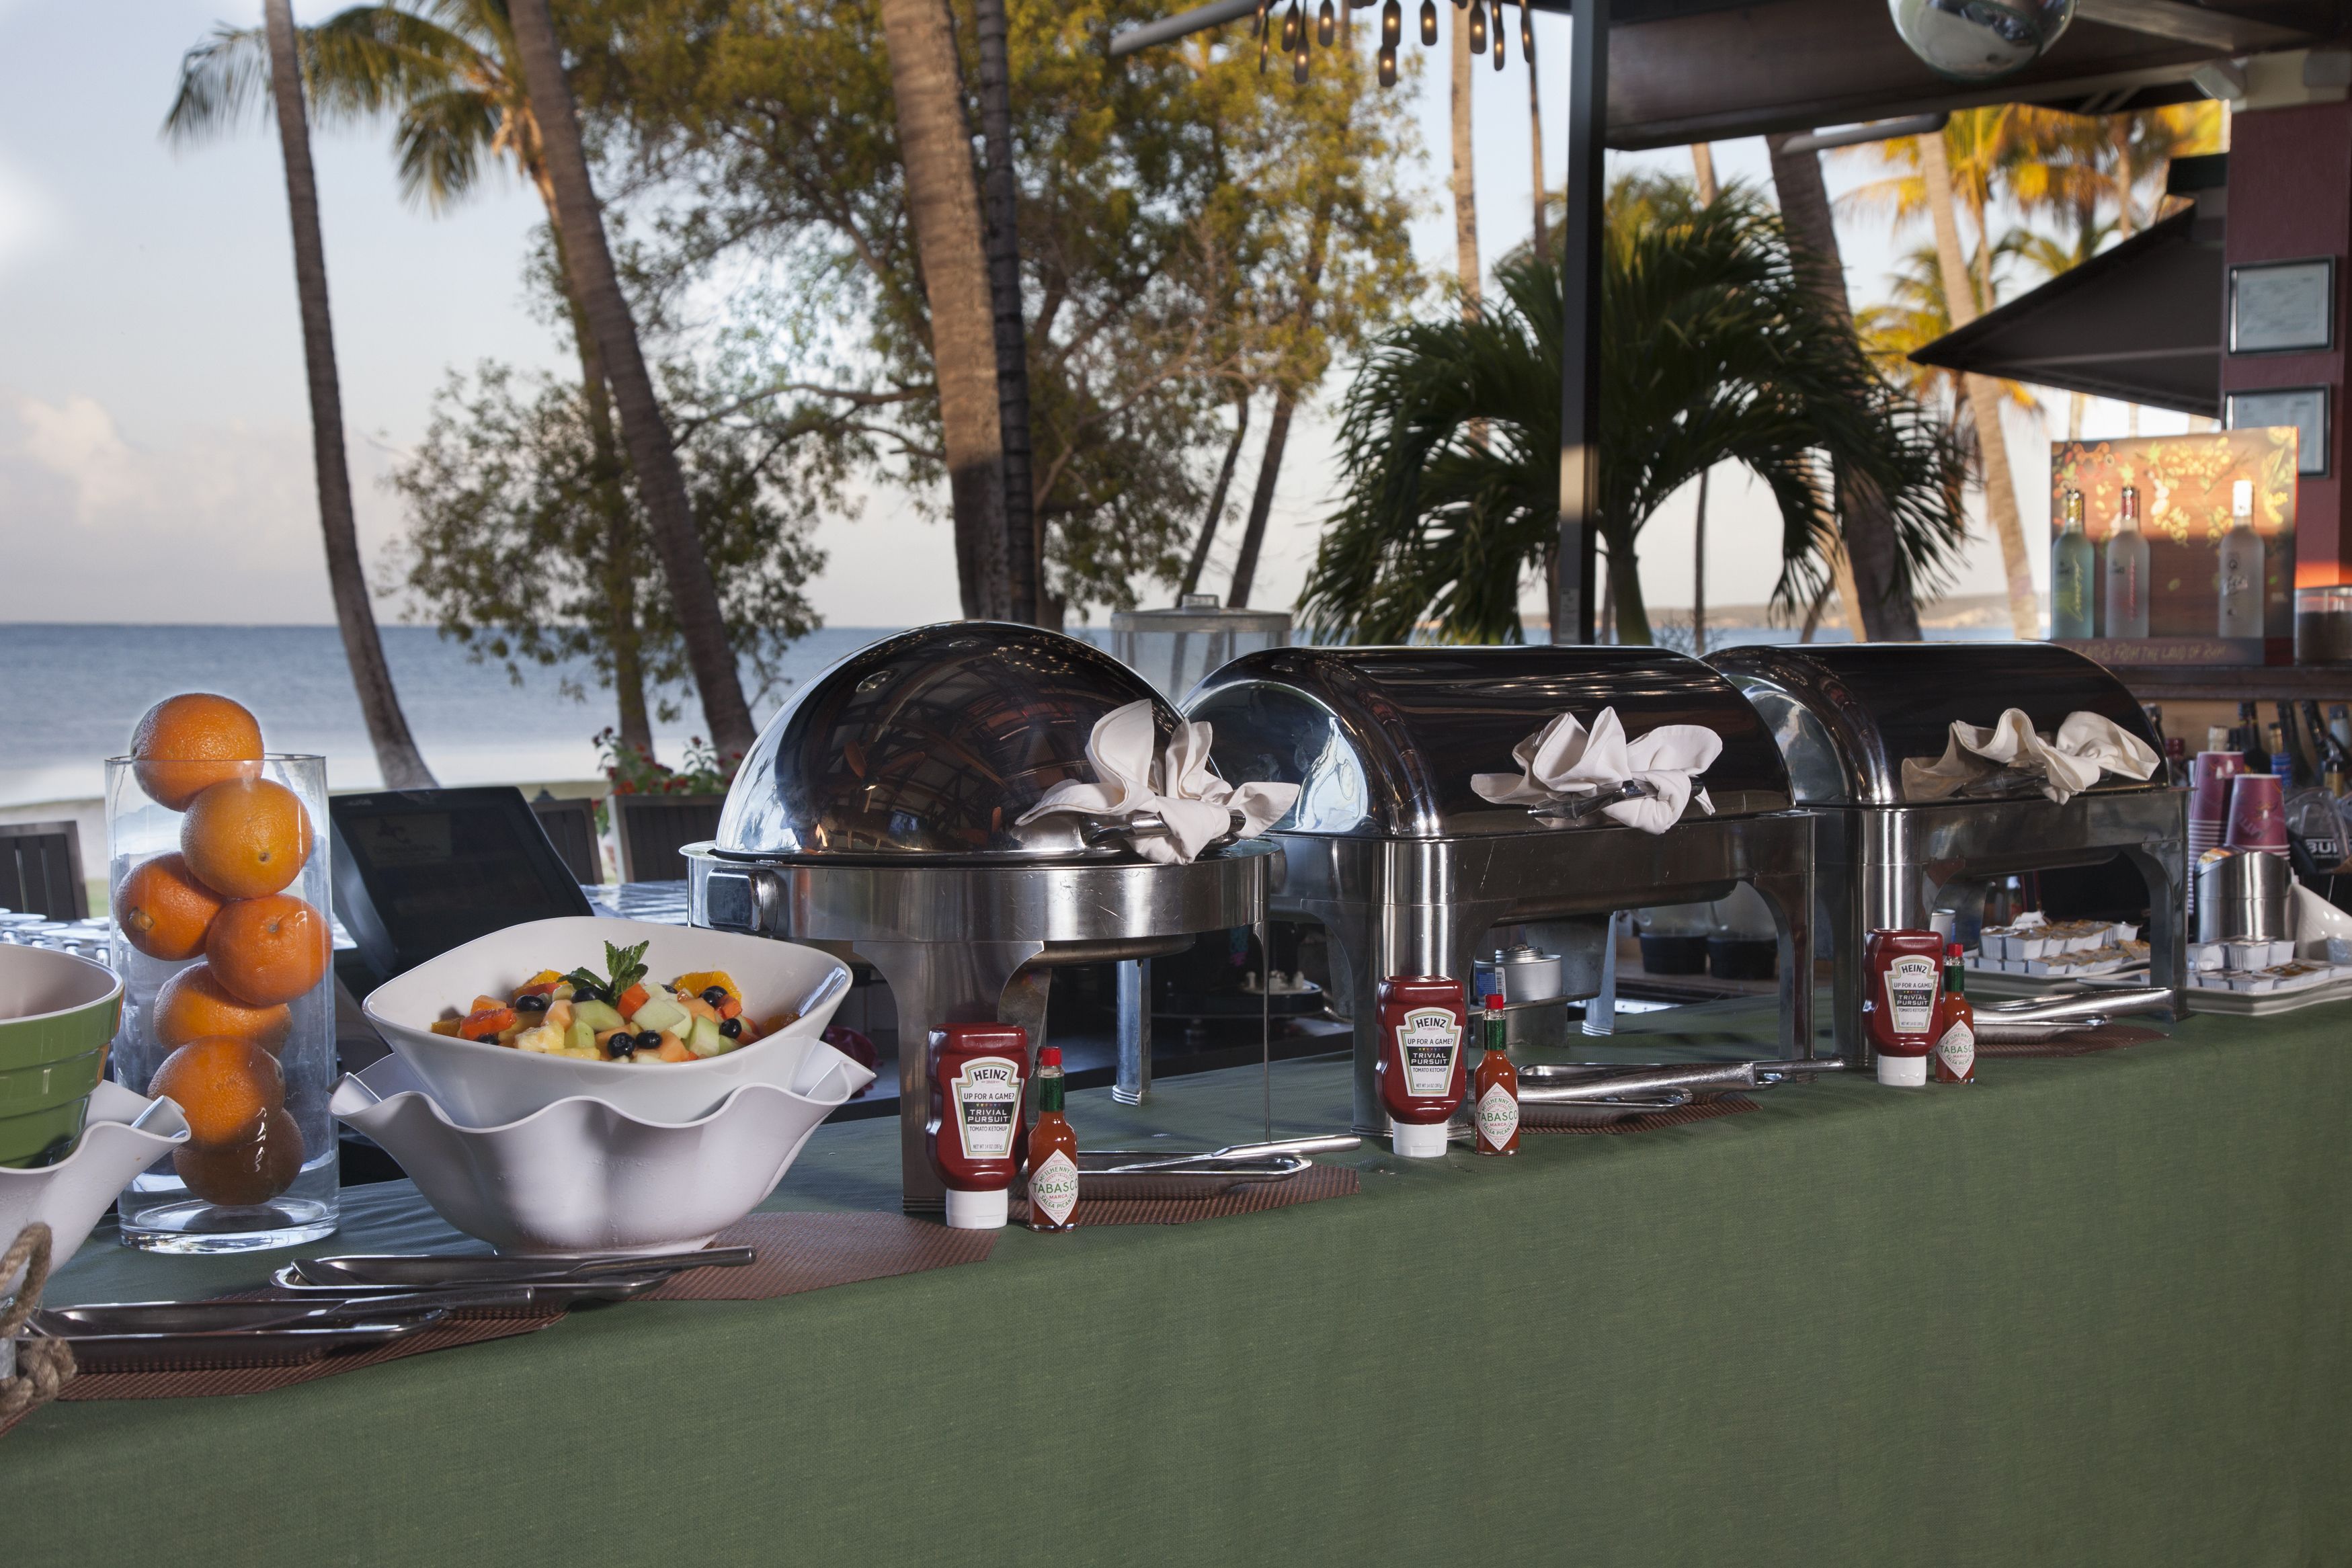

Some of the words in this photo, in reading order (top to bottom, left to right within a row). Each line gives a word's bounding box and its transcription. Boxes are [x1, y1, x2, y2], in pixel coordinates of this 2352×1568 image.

[1901, 964, 1928, 973] HEINZ
[1416, 1018, 1446, 1028] HEINZ
[973, 1069, 1008, 1081] HEINZ
[1477, 1110, 1518, 1122] TABASCO
[1483, 1122, 1495, 1135] SALSA
[1496, 1122, 1514, 1135] PICANTE
[1040, 1194, 1055, 1208] SALSA
[1057, 1193, 1075, 1208] PICANTE
